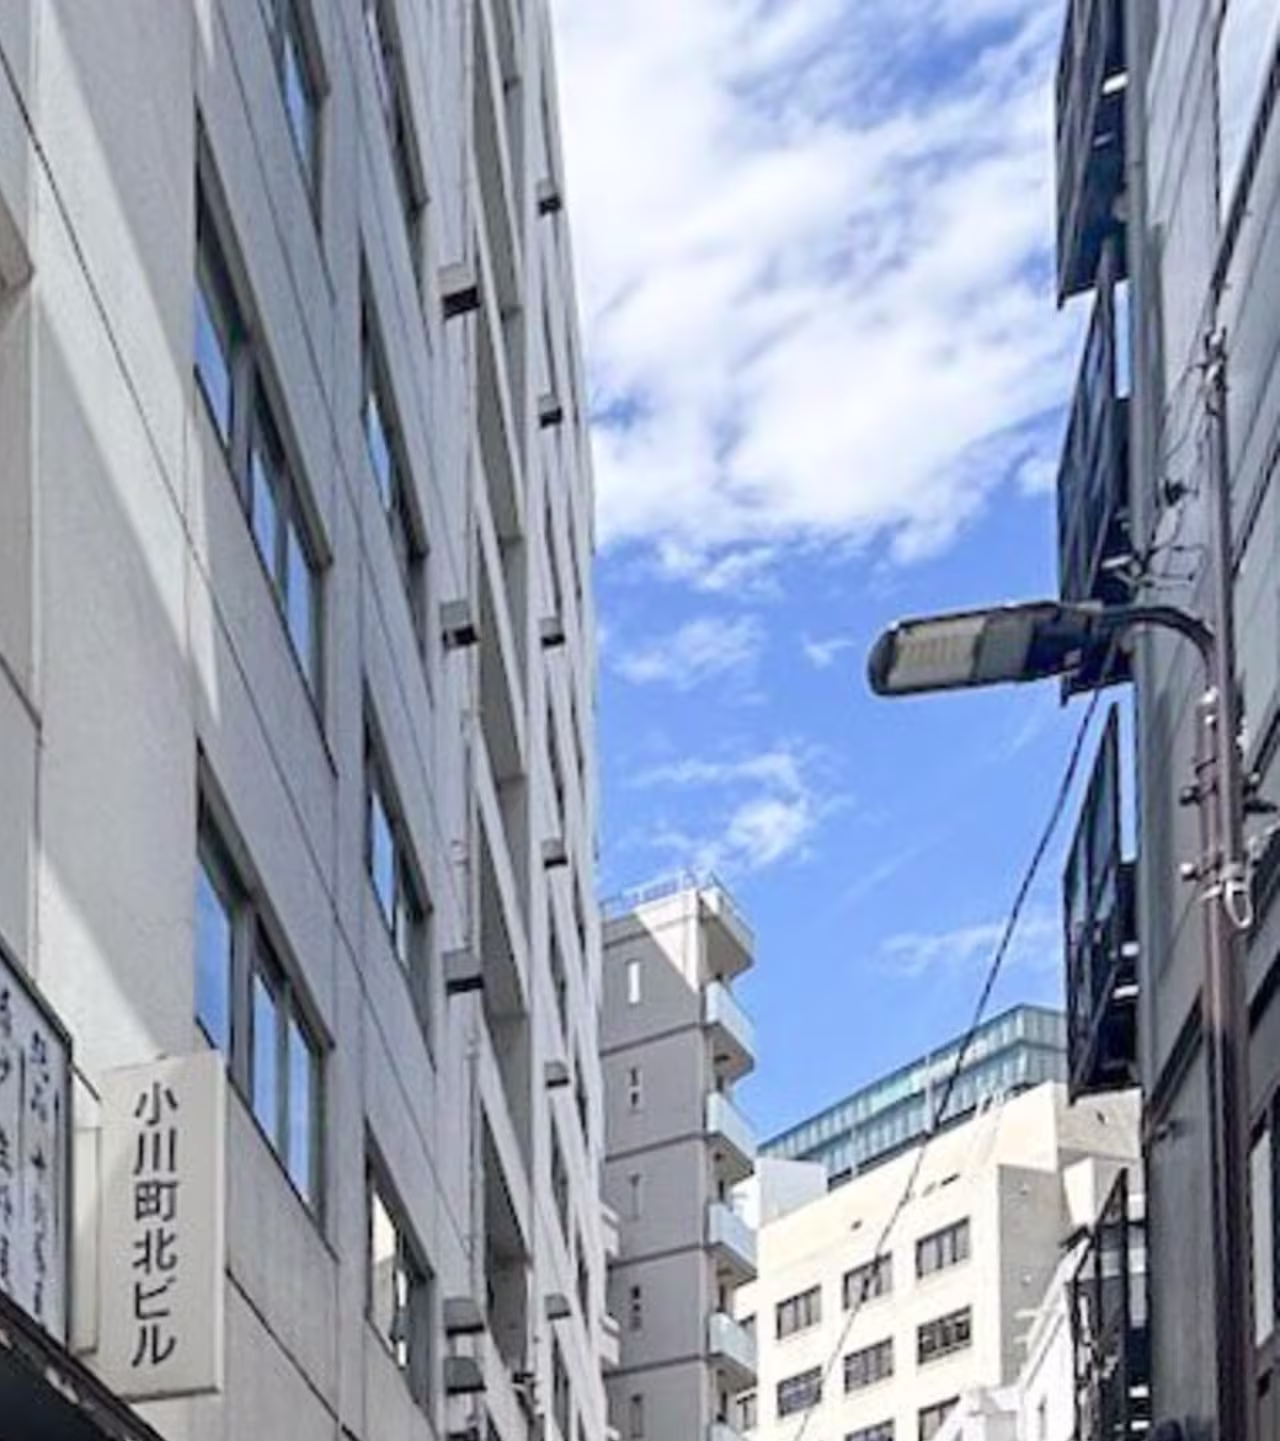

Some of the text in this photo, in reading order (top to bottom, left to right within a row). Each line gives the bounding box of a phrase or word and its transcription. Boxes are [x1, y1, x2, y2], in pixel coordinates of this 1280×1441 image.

[129, 1081, 179, 1370] 小川町北ビル
